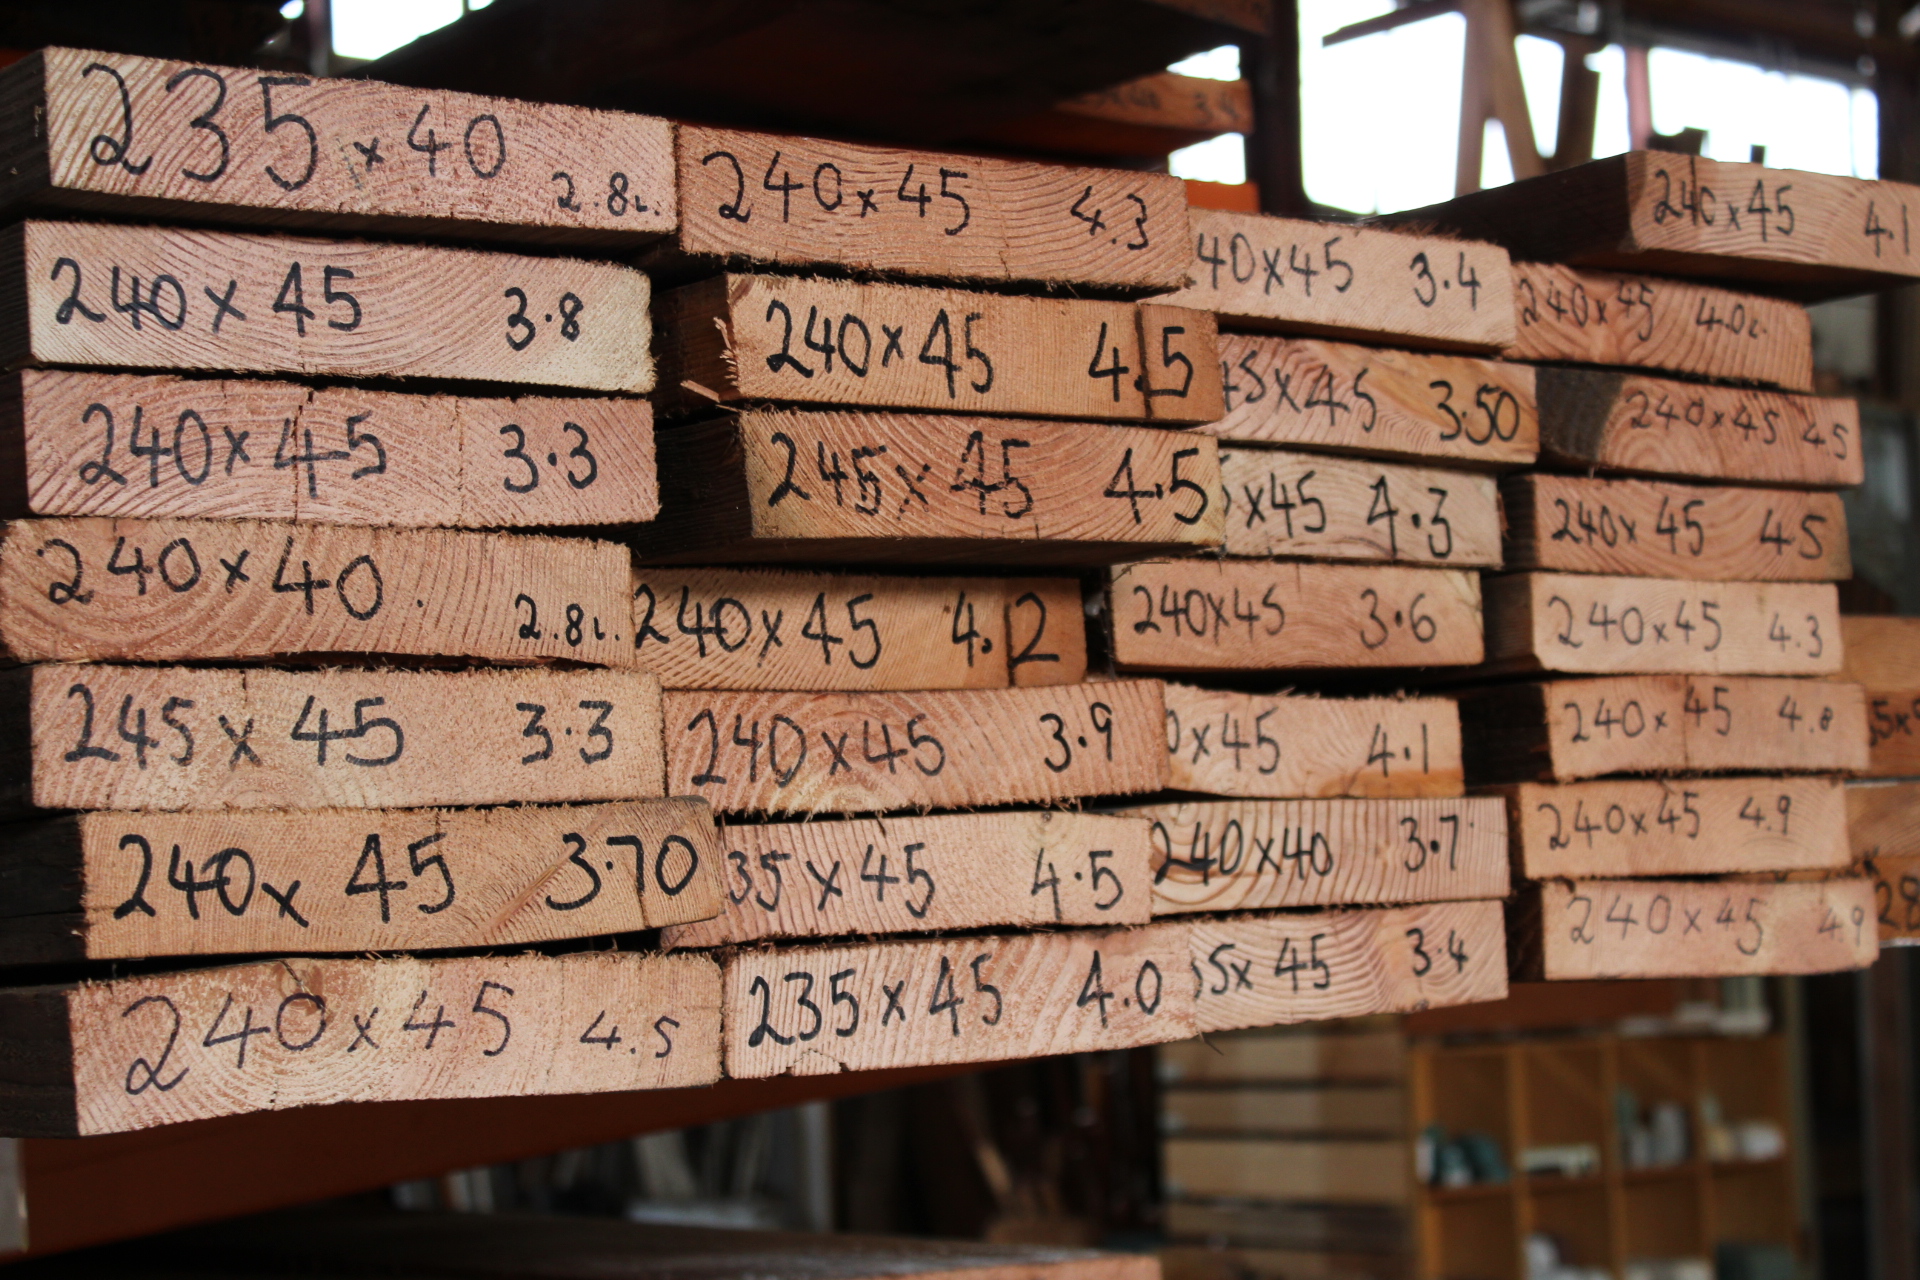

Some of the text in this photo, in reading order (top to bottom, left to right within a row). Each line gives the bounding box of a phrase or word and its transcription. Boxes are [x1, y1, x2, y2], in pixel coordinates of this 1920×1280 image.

[1069, 185, 1149, 250] 4.3
[1863, 200, 1911, 258] 4.1
[1192, 231, 1482, 311] 40x45 3.4
[503, 286, 584, 351] 3.8
[1087, 321, 1194, 403] 4.5
[1429, 379, 1520, 446] 3.50
[500, 421, 598, 493] 3.3
[1102, 447, 1209, 525] 4.5
[1367, 475, 1452, 559] 4.3
[951, 590, 1060, 668] 4.2
[1360, 587, 1437, 650] 3.6
[1768, 612, 1824, 659] 4.3
[516, 700, 614, 766] 3.3
[1038, 702, 1114, 773] 3.9
[1778, 695, 1835, 735] 4.8
[1367, 722, 1430, 778] 4.1
[1400, 814, 1460, 873] 3.7
[1738, 795, 1792, 837] 4.9
[545, 831, 698, 911] 3.70
[722, 842, 1125, 921] 35x45 4.5
[1405, 927, 1469, 978] 3.4
[1817, 905, 1865, 947] 4.9
[1076, 949, 1162, 1029] 4.0
[579, 1010, 681, 1059] 4.5
